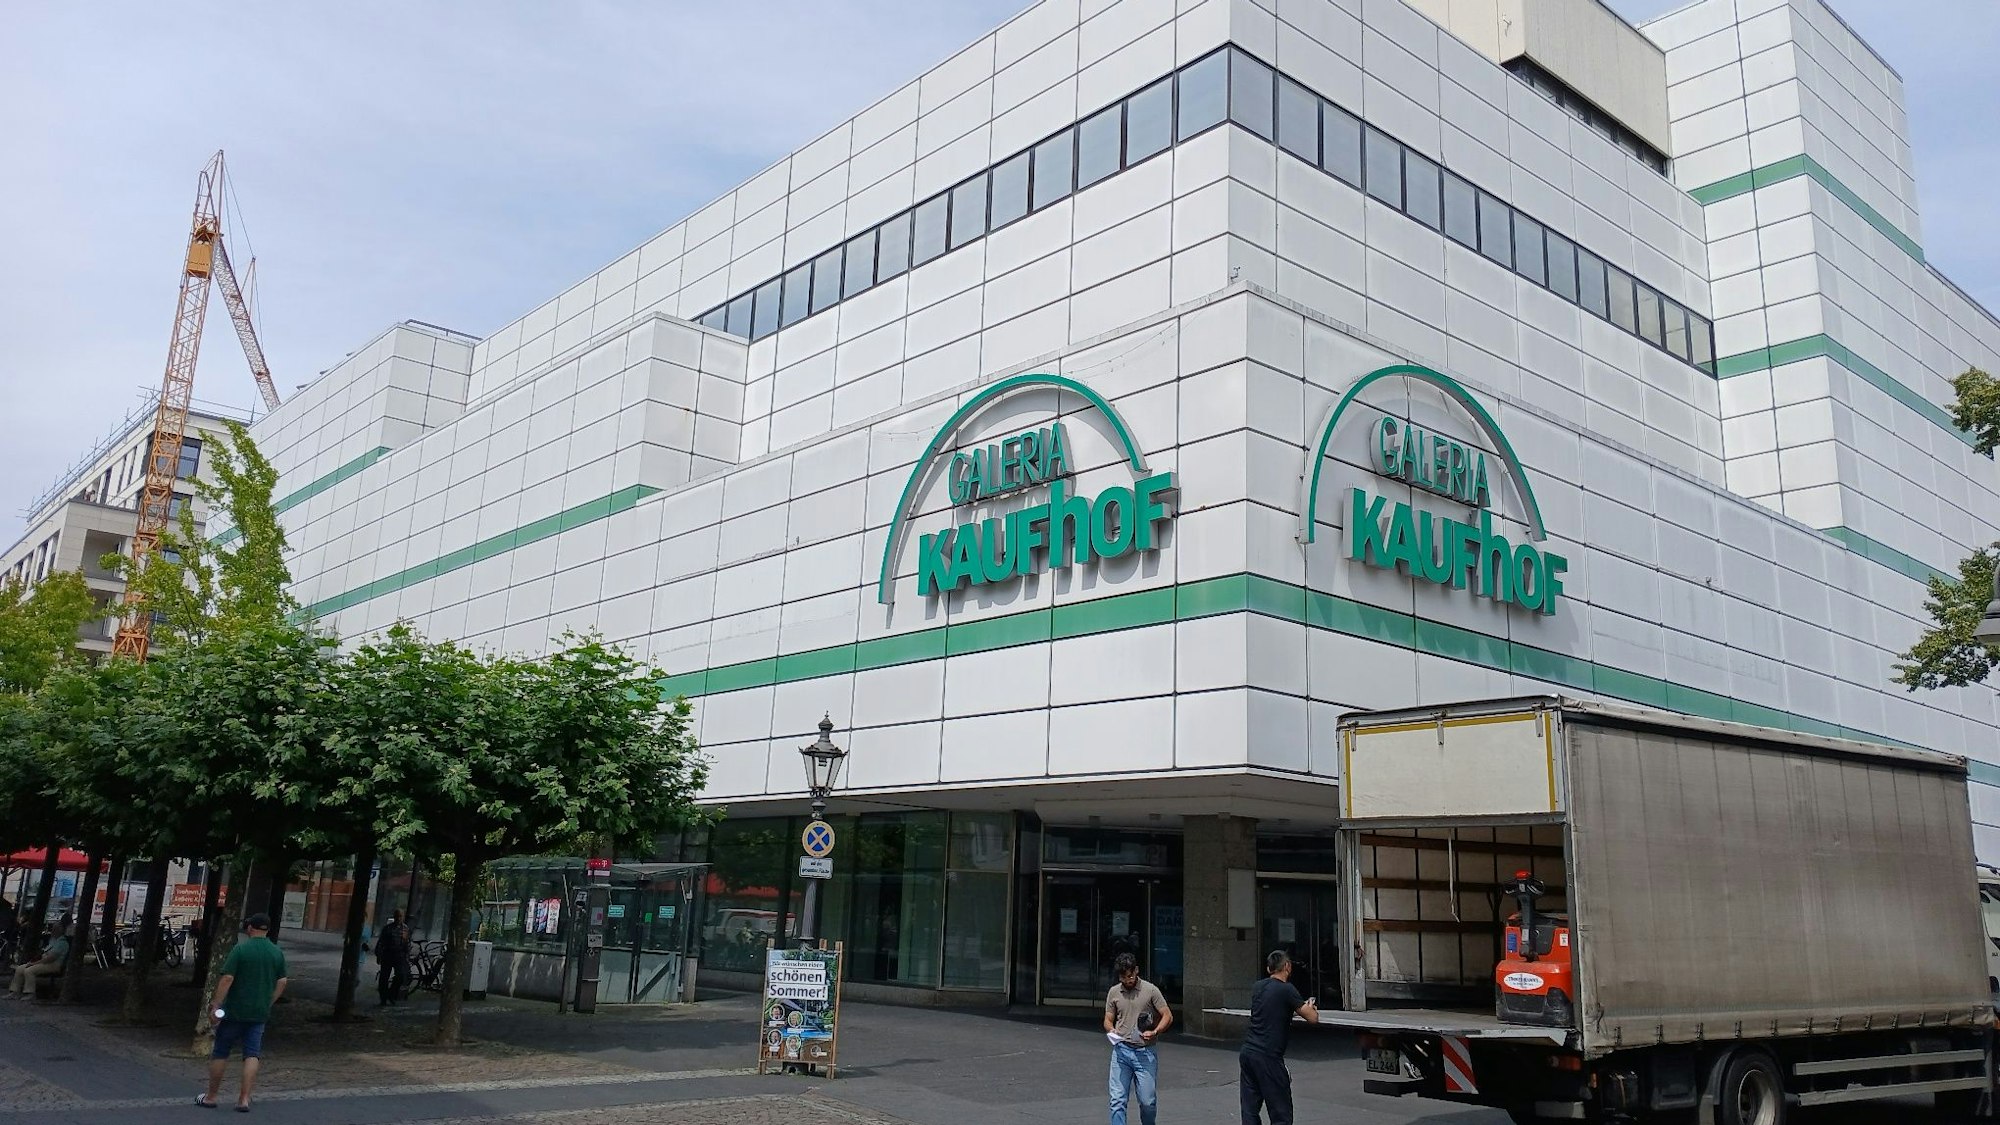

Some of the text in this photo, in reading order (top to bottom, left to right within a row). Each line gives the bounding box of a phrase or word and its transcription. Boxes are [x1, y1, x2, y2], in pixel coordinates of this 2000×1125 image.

[949, 422, 1071, 504] GALERIA
[1374, 416, 1491, 507] GALERIA
[770, 984, 826, 998] Sommer!
[771, 969, 822, 982] schönen
